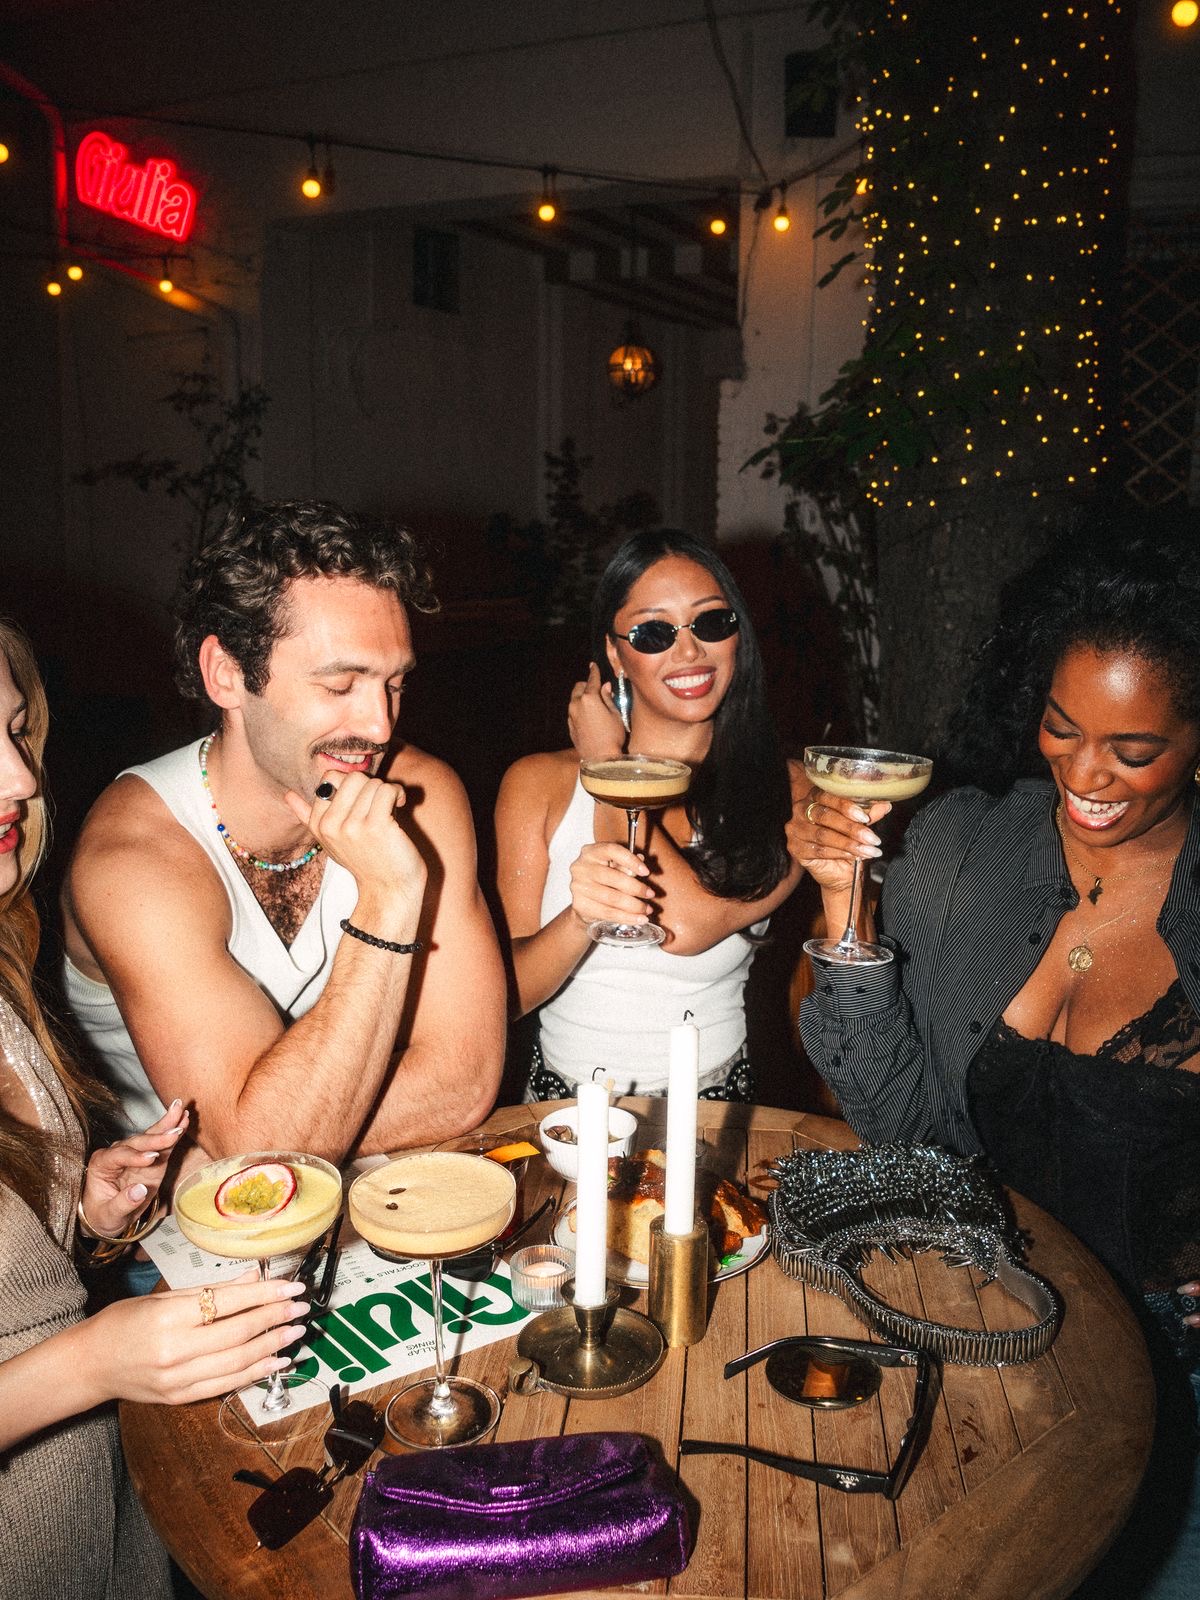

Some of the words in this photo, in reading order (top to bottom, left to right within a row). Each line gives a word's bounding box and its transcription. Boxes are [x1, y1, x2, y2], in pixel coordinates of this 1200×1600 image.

[76, 131, 197, 242] Giulia
[376, 1261, 426, 1278] COCKTAILS
[405, 1340, 437, 1350] RINKS
[836, 1473, 860, 1482] PRADA
